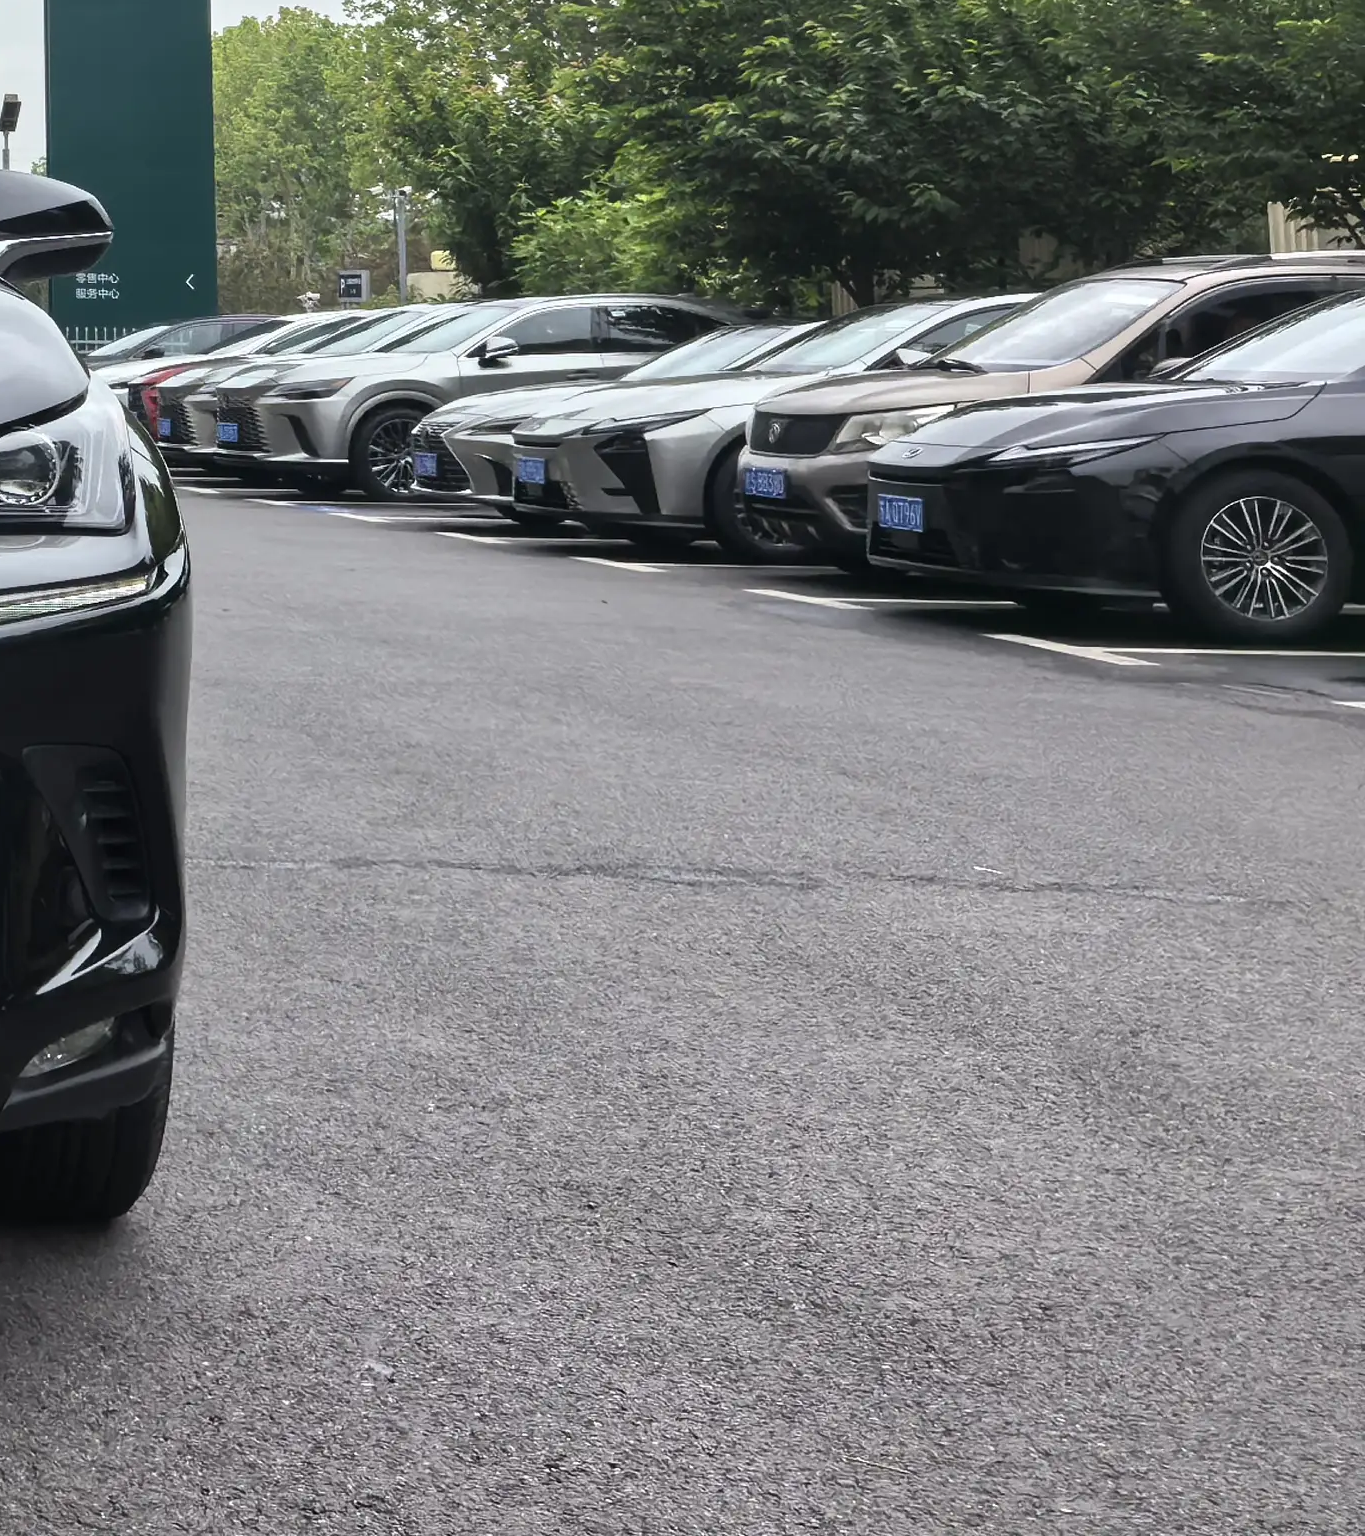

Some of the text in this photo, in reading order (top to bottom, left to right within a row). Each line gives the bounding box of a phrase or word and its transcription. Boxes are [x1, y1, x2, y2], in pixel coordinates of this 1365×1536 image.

[75, 272, 120, 284] 零售中心
[75, 287, 120, 300] 服务中心
